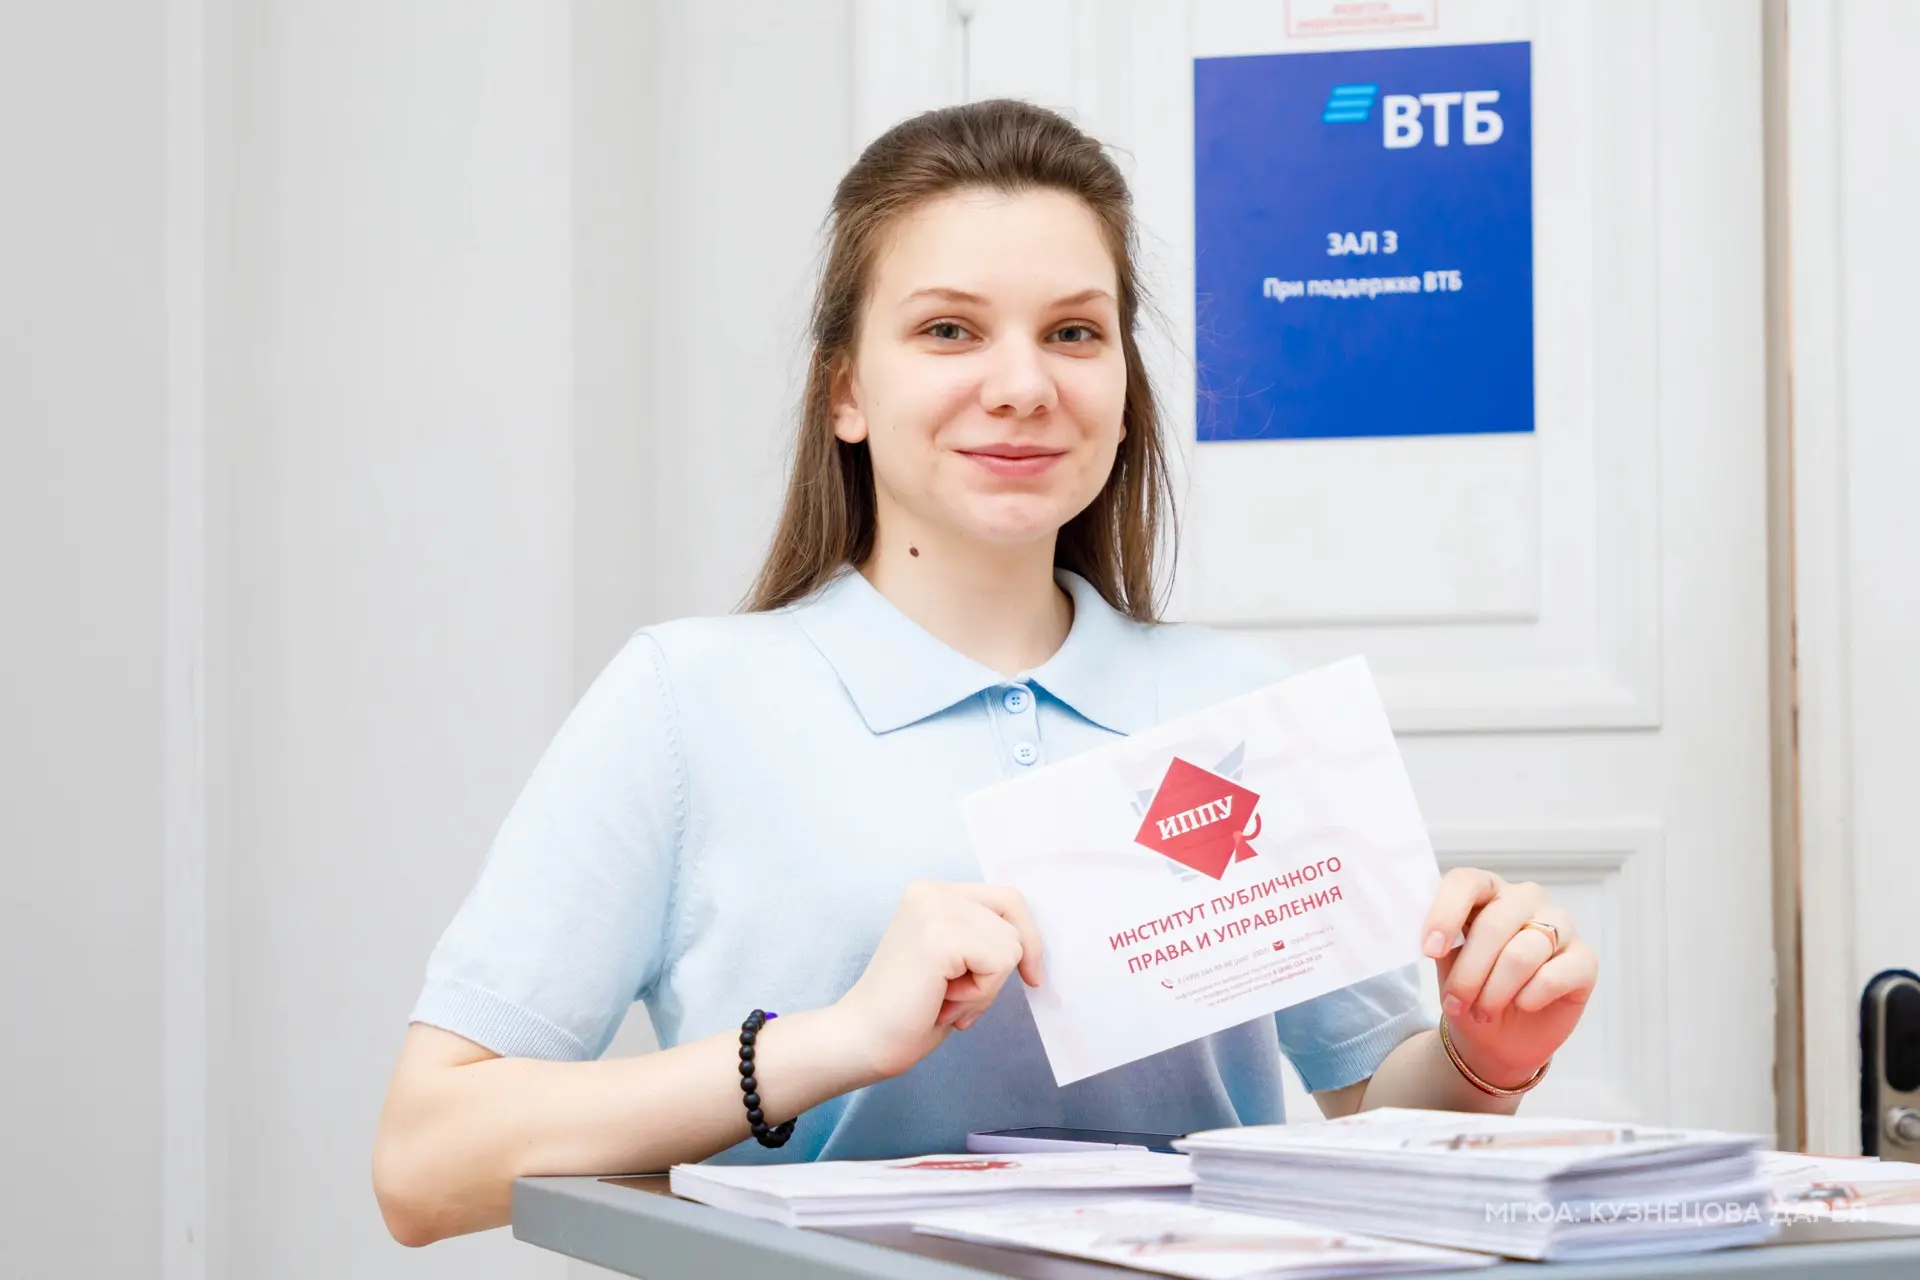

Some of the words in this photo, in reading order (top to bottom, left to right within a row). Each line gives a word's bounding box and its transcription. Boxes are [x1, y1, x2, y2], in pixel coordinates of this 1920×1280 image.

[1383, 90, 1503, 149] ВТБ
[1327, 231, 1378, 256] ЗАЛ
[1382, 230, 1398, 254] 3
[1264, 277, 1304, 302] При
[1307, 276, 1421, 300] поддержке
[1424, 270, 1462, 292] ВТБ
[1156, 795, 1233, 841] ИППУ
[1109, 904, 1206, 951] ИНСТИТУТ
[1211, 856, 1342, 915] ПУБЛИЧНОГО
[1127, 939, 1193, 974] ПРАВА
[1196, 932, 1211, 951] И
[1213, 885, 1343, 943] УПРАВЛЕНИЯ
